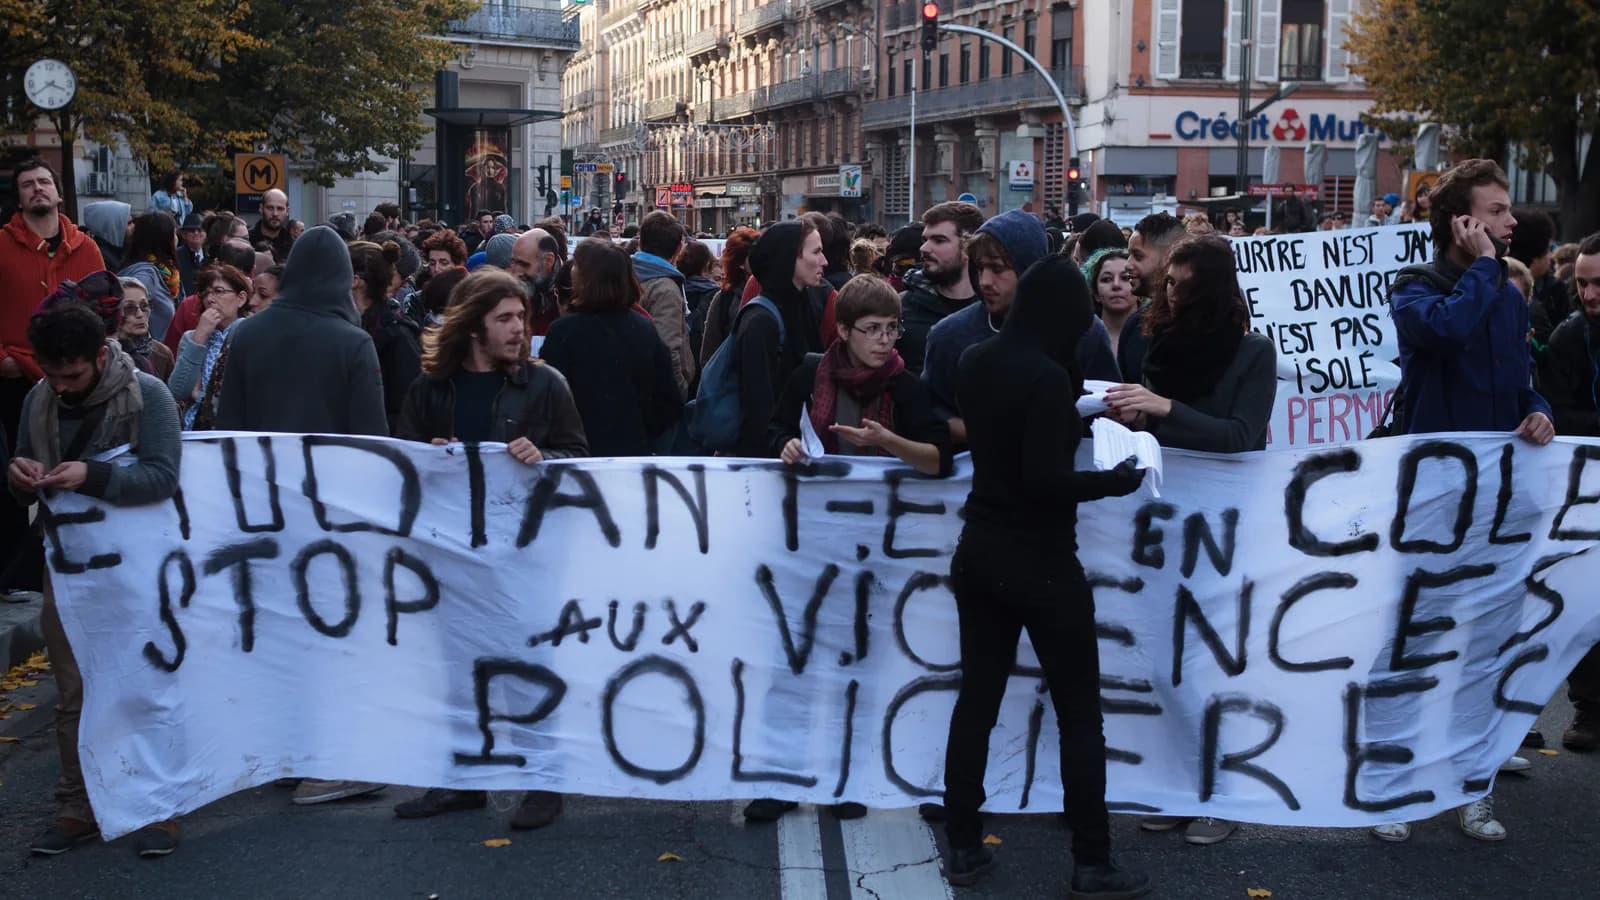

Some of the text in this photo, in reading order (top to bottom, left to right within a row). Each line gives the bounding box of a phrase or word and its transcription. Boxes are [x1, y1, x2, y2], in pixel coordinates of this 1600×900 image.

[250, 163, 272, 185] M
[1323, 232, 1379, 269] N'EST
[1331, 313, 1383, 350] PAS
[1131, 502, 1240, 579] EN
[142, 538, 440, 673] STOP
[526, 599, 706, 653] AUX
